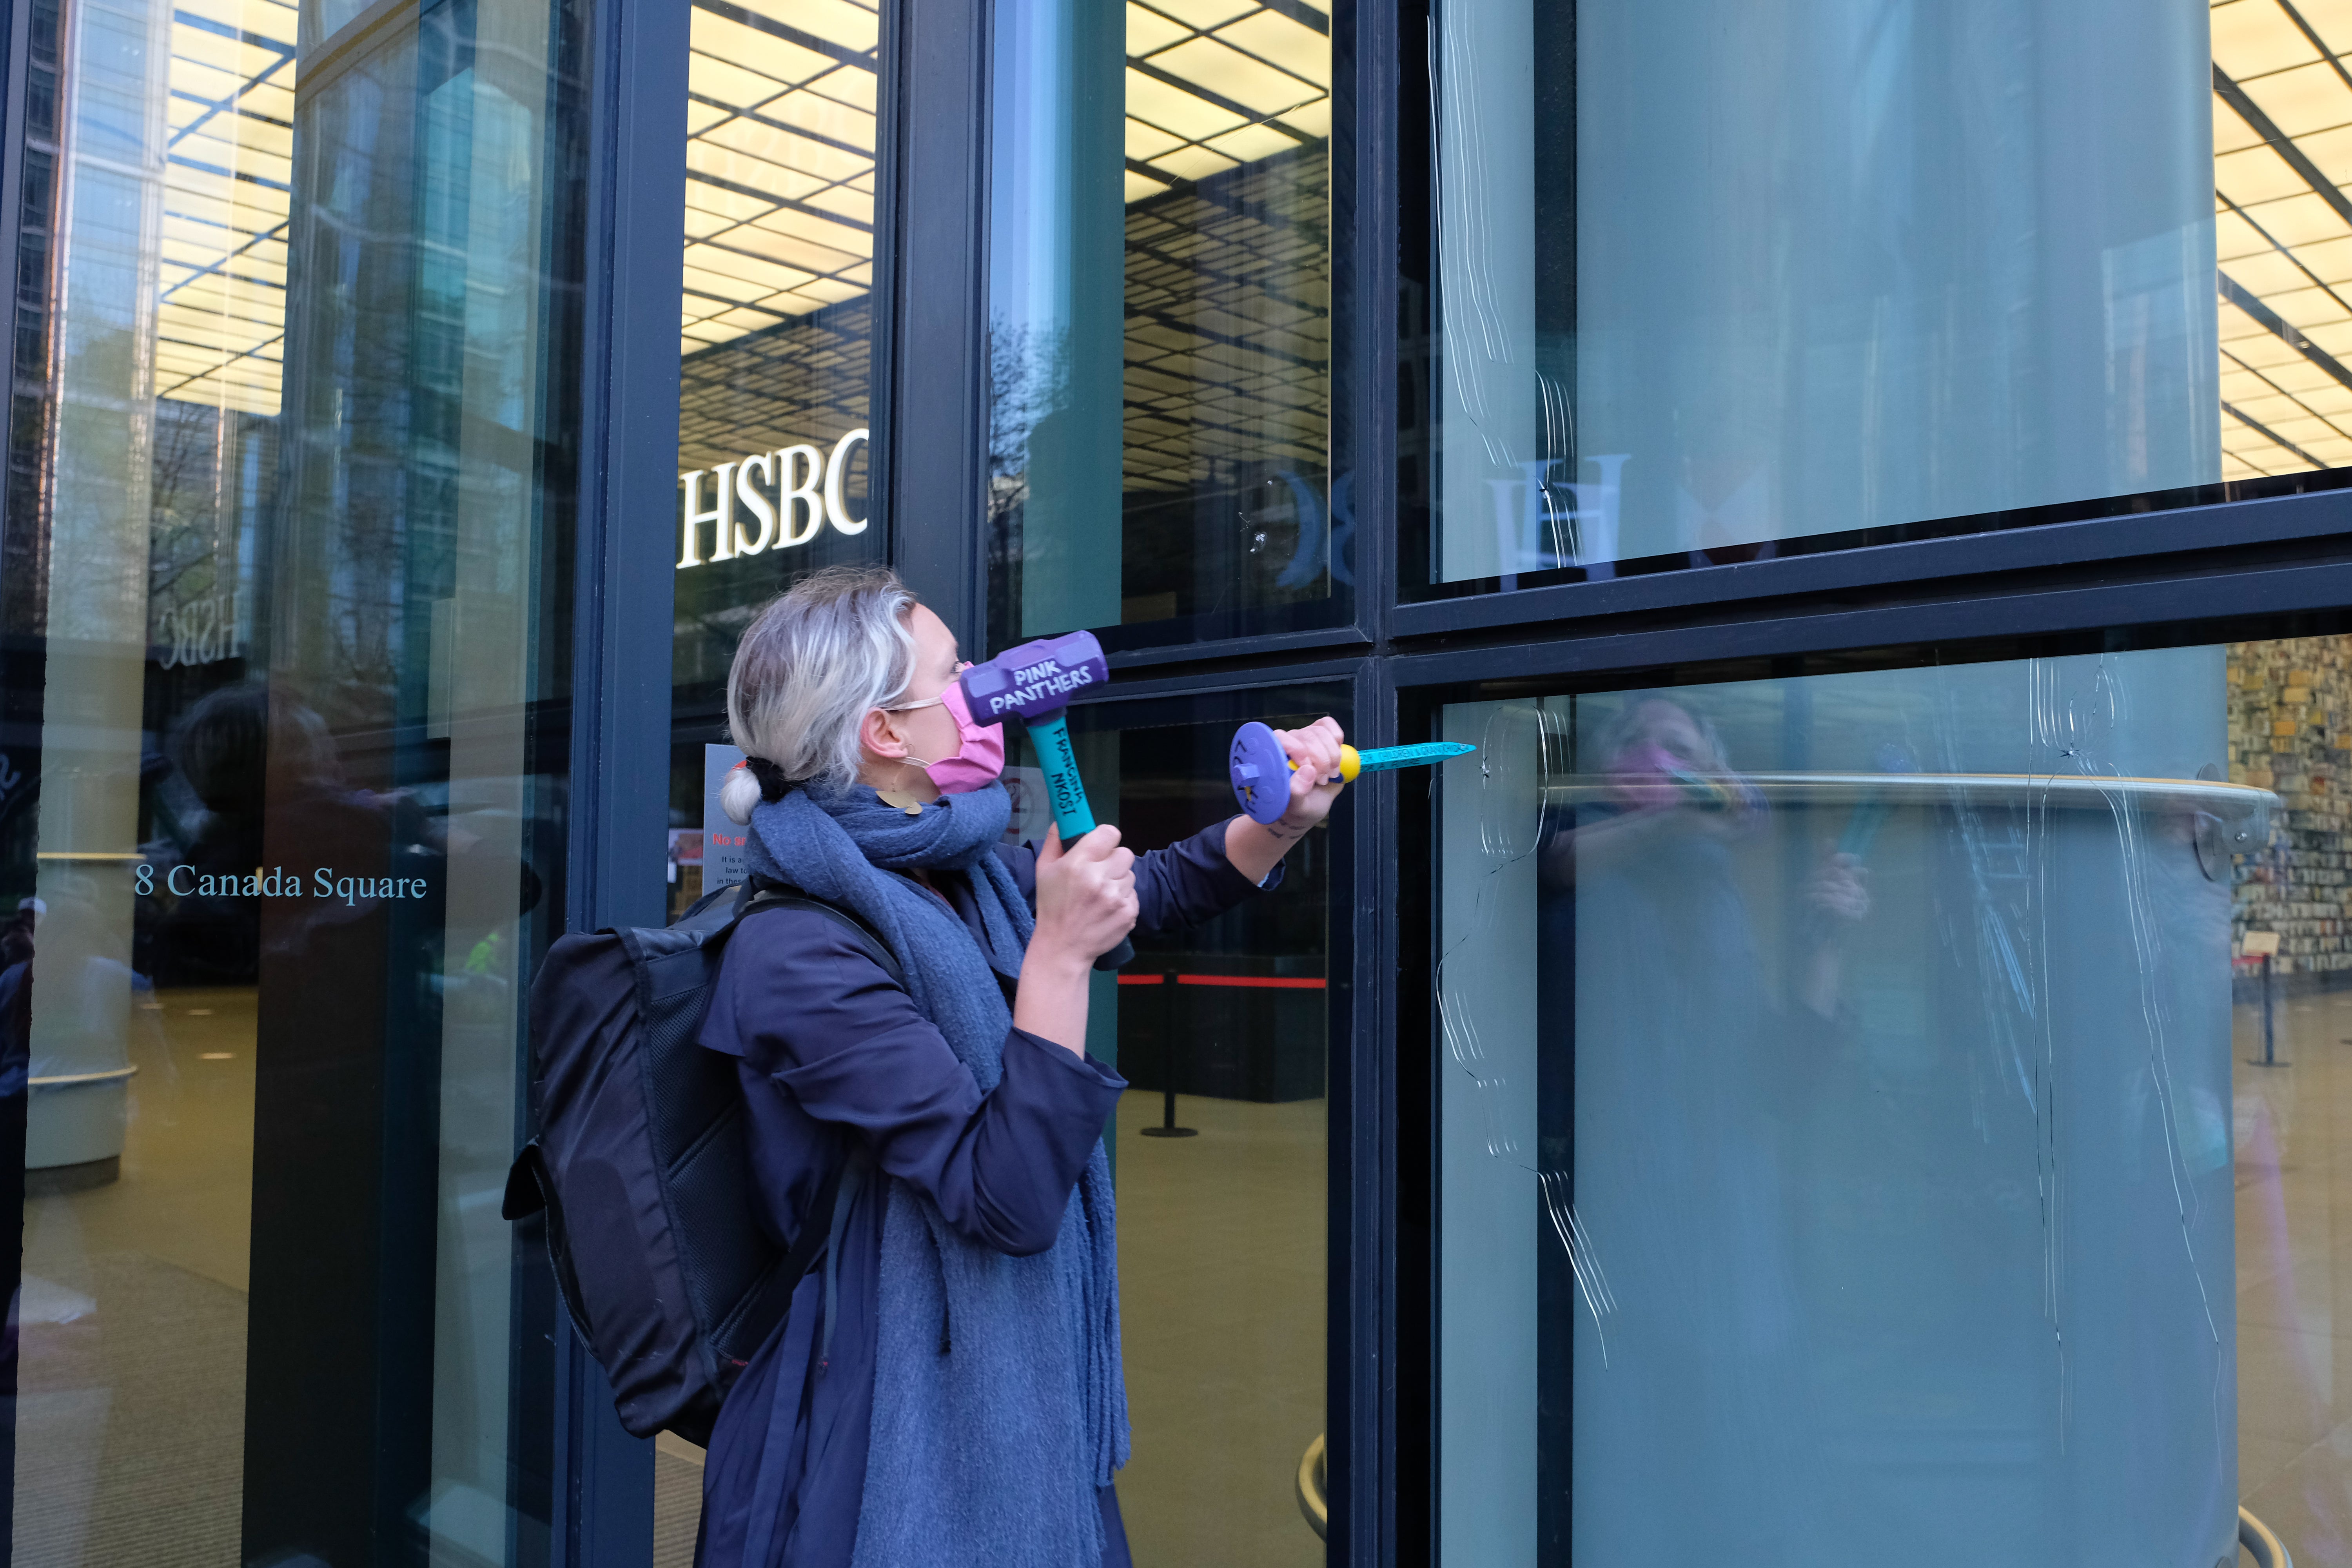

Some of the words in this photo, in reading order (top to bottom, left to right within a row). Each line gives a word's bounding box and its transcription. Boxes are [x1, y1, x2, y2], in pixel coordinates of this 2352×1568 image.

[676, 428, 869, 570] HSBC
[989, 665, 1093, 715] PANTHERS
[1014, 659, 1062, 686] PINK
[1051, 772, 1078, 816] NKOSI
[713, 833, 731, 846] No
[134, 864, 154, 897] 8
[167, 864, 303, 898] Canada
[313, 867, 427, 907] Square
